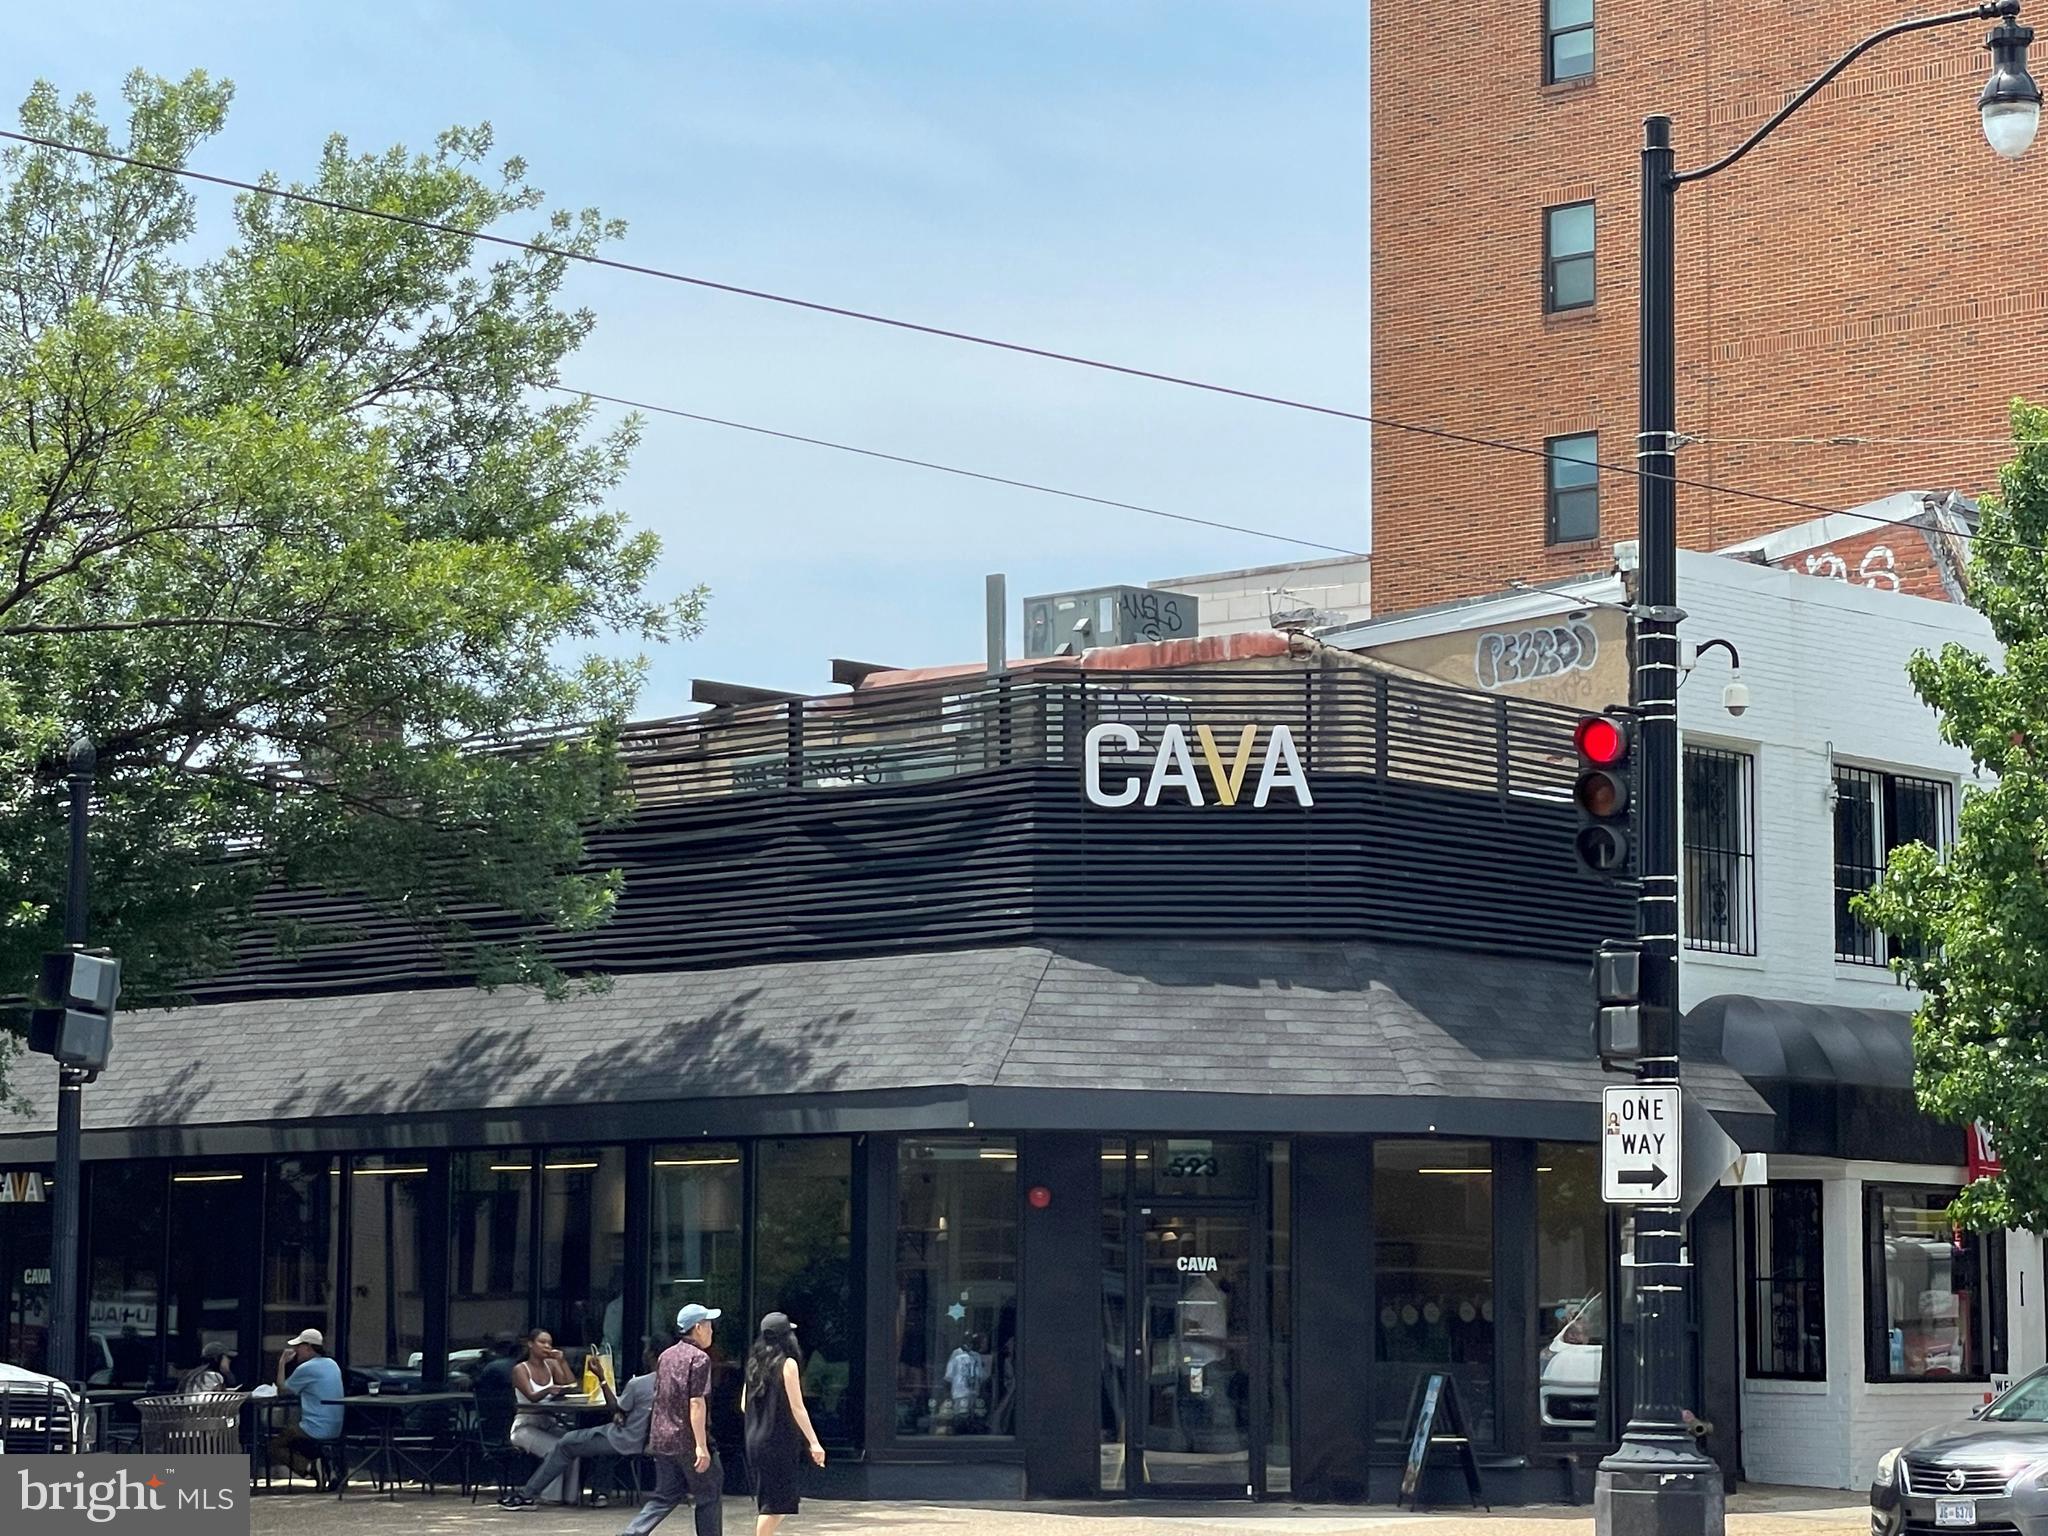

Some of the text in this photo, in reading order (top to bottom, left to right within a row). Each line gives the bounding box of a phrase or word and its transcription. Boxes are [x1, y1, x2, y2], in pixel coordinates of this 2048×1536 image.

[1085, 723, 1314, 807] CAVA
[1622, 1099, 1664, 1120] ONE
[1622, 1133, 1665, 1154] WAY
[1177, 1257, 1217, 1271] CAVA
[24, 1268, 51, 1284] CAVA
